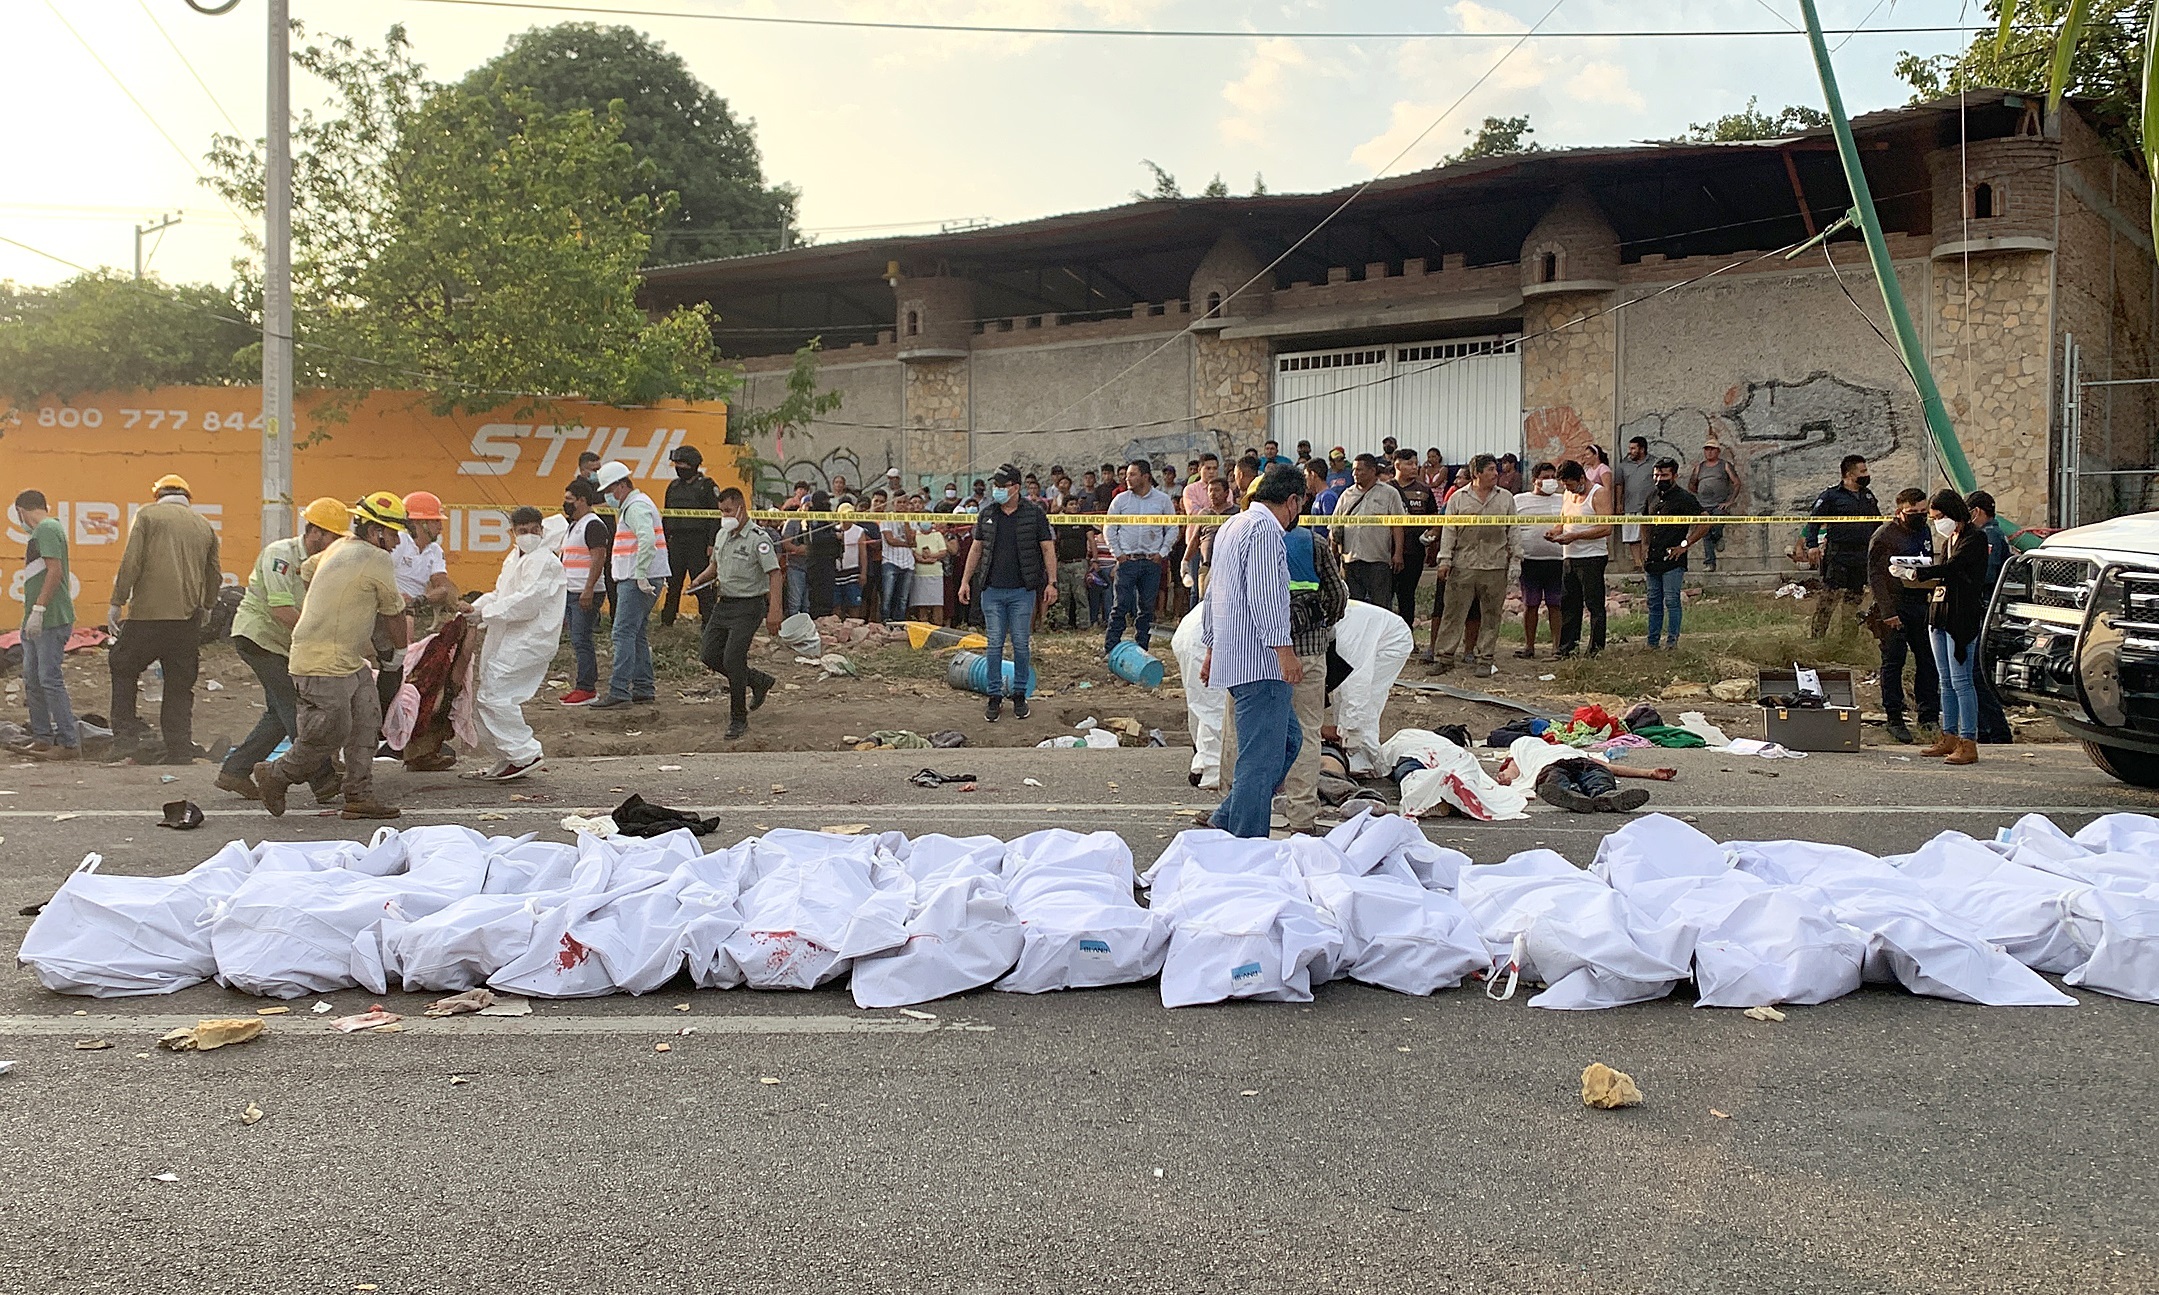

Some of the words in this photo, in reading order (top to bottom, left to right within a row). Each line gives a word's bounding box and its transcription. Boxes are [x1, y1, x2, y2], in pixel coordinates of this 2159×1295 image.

[38, 407, 102, 428] 800
[120, 409, 188, 429] 777
[457, 423, 708, 480] STIHL
